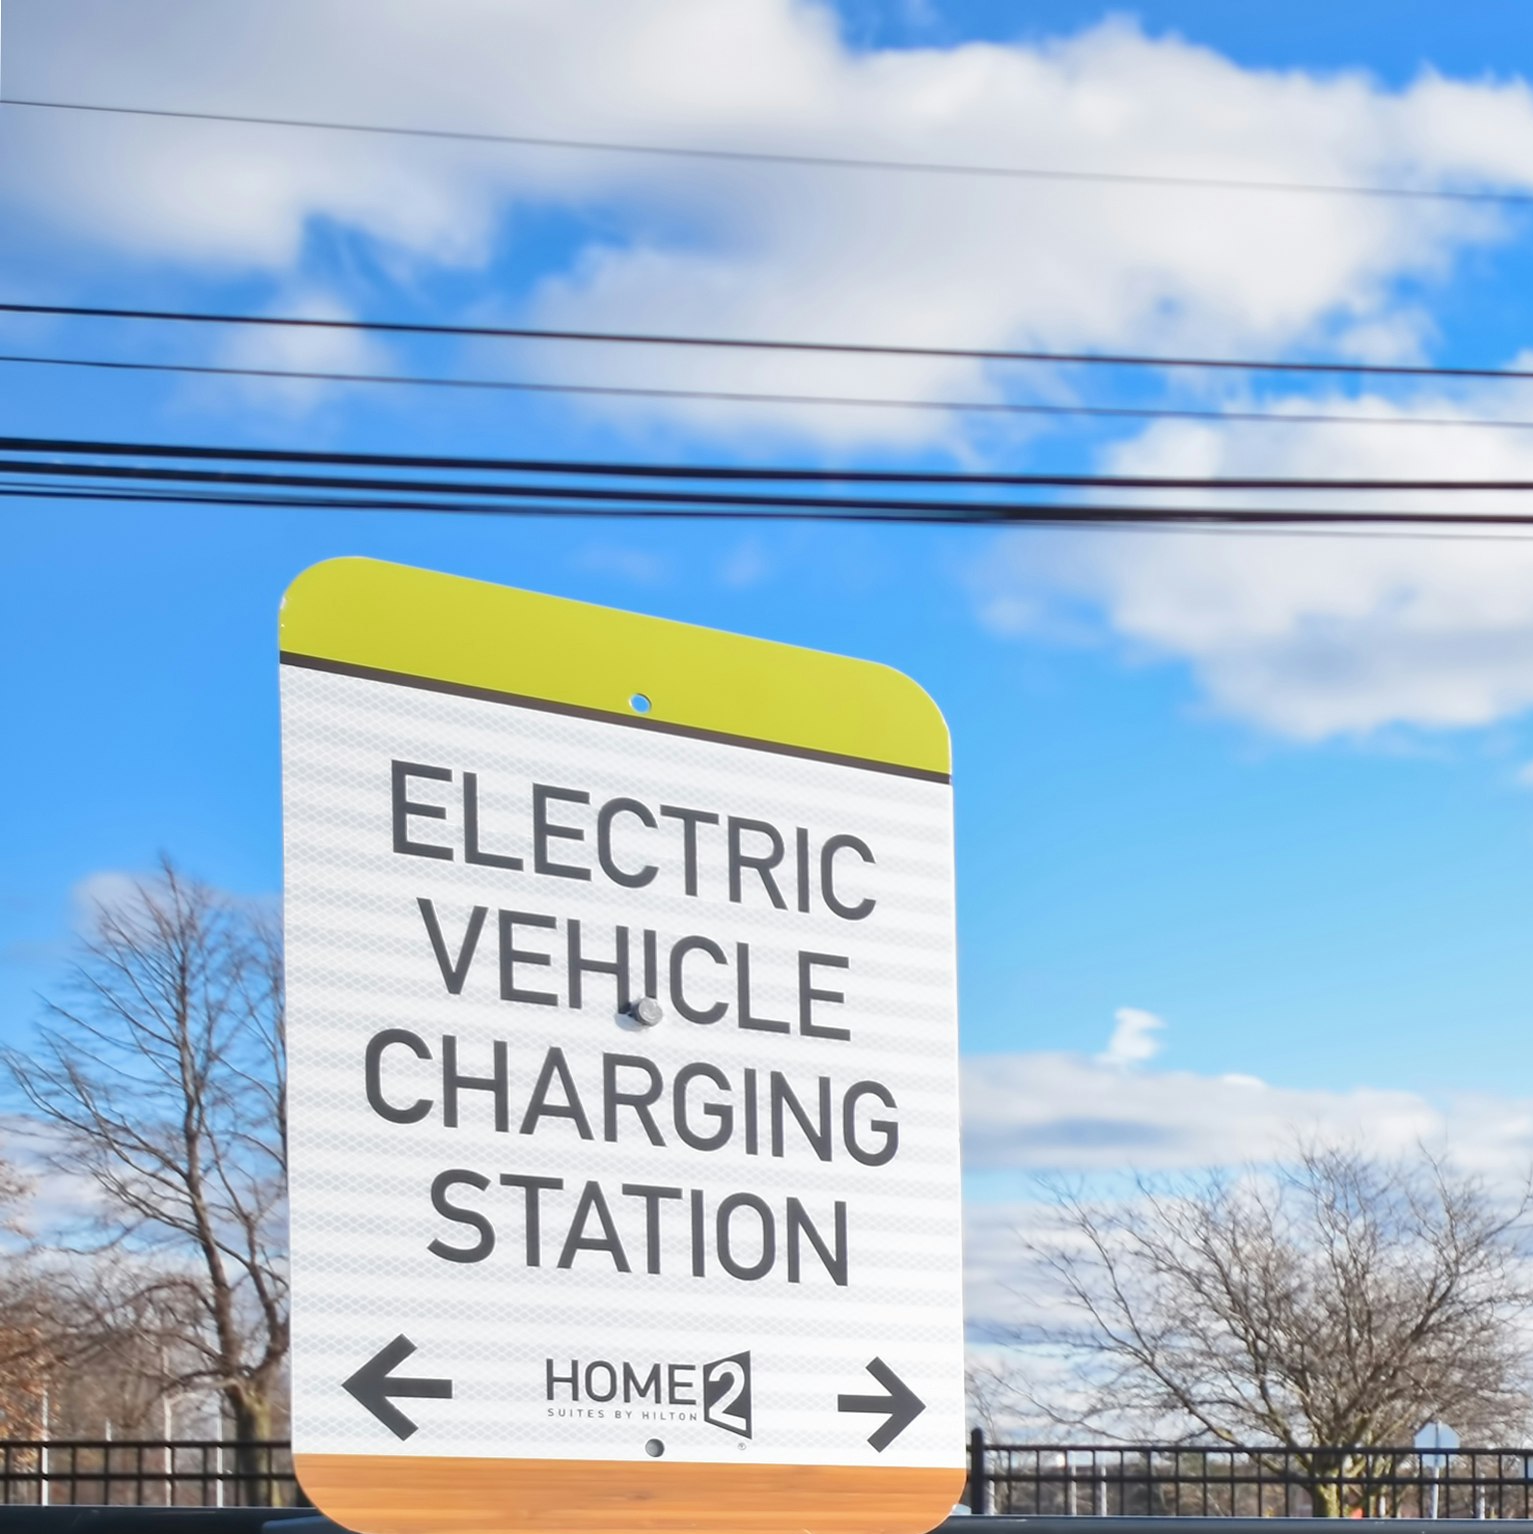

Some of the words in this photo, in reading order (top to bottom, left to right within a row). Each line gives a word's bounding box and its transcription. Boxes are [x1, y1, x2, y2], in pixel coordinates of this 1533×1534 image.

[391, 759, 876, 921] ELECTRIC
[416, 897, 851, 1042] VEHICLE
[365, 1028, 899, 1167] CHARGING
[427, 1169, 848, 1287] STATION
[547, 1407, 605, 1419] SUITES
[614, 1410, 633, 1419] BY
[641, 1411, 697, 1421] HILTON
